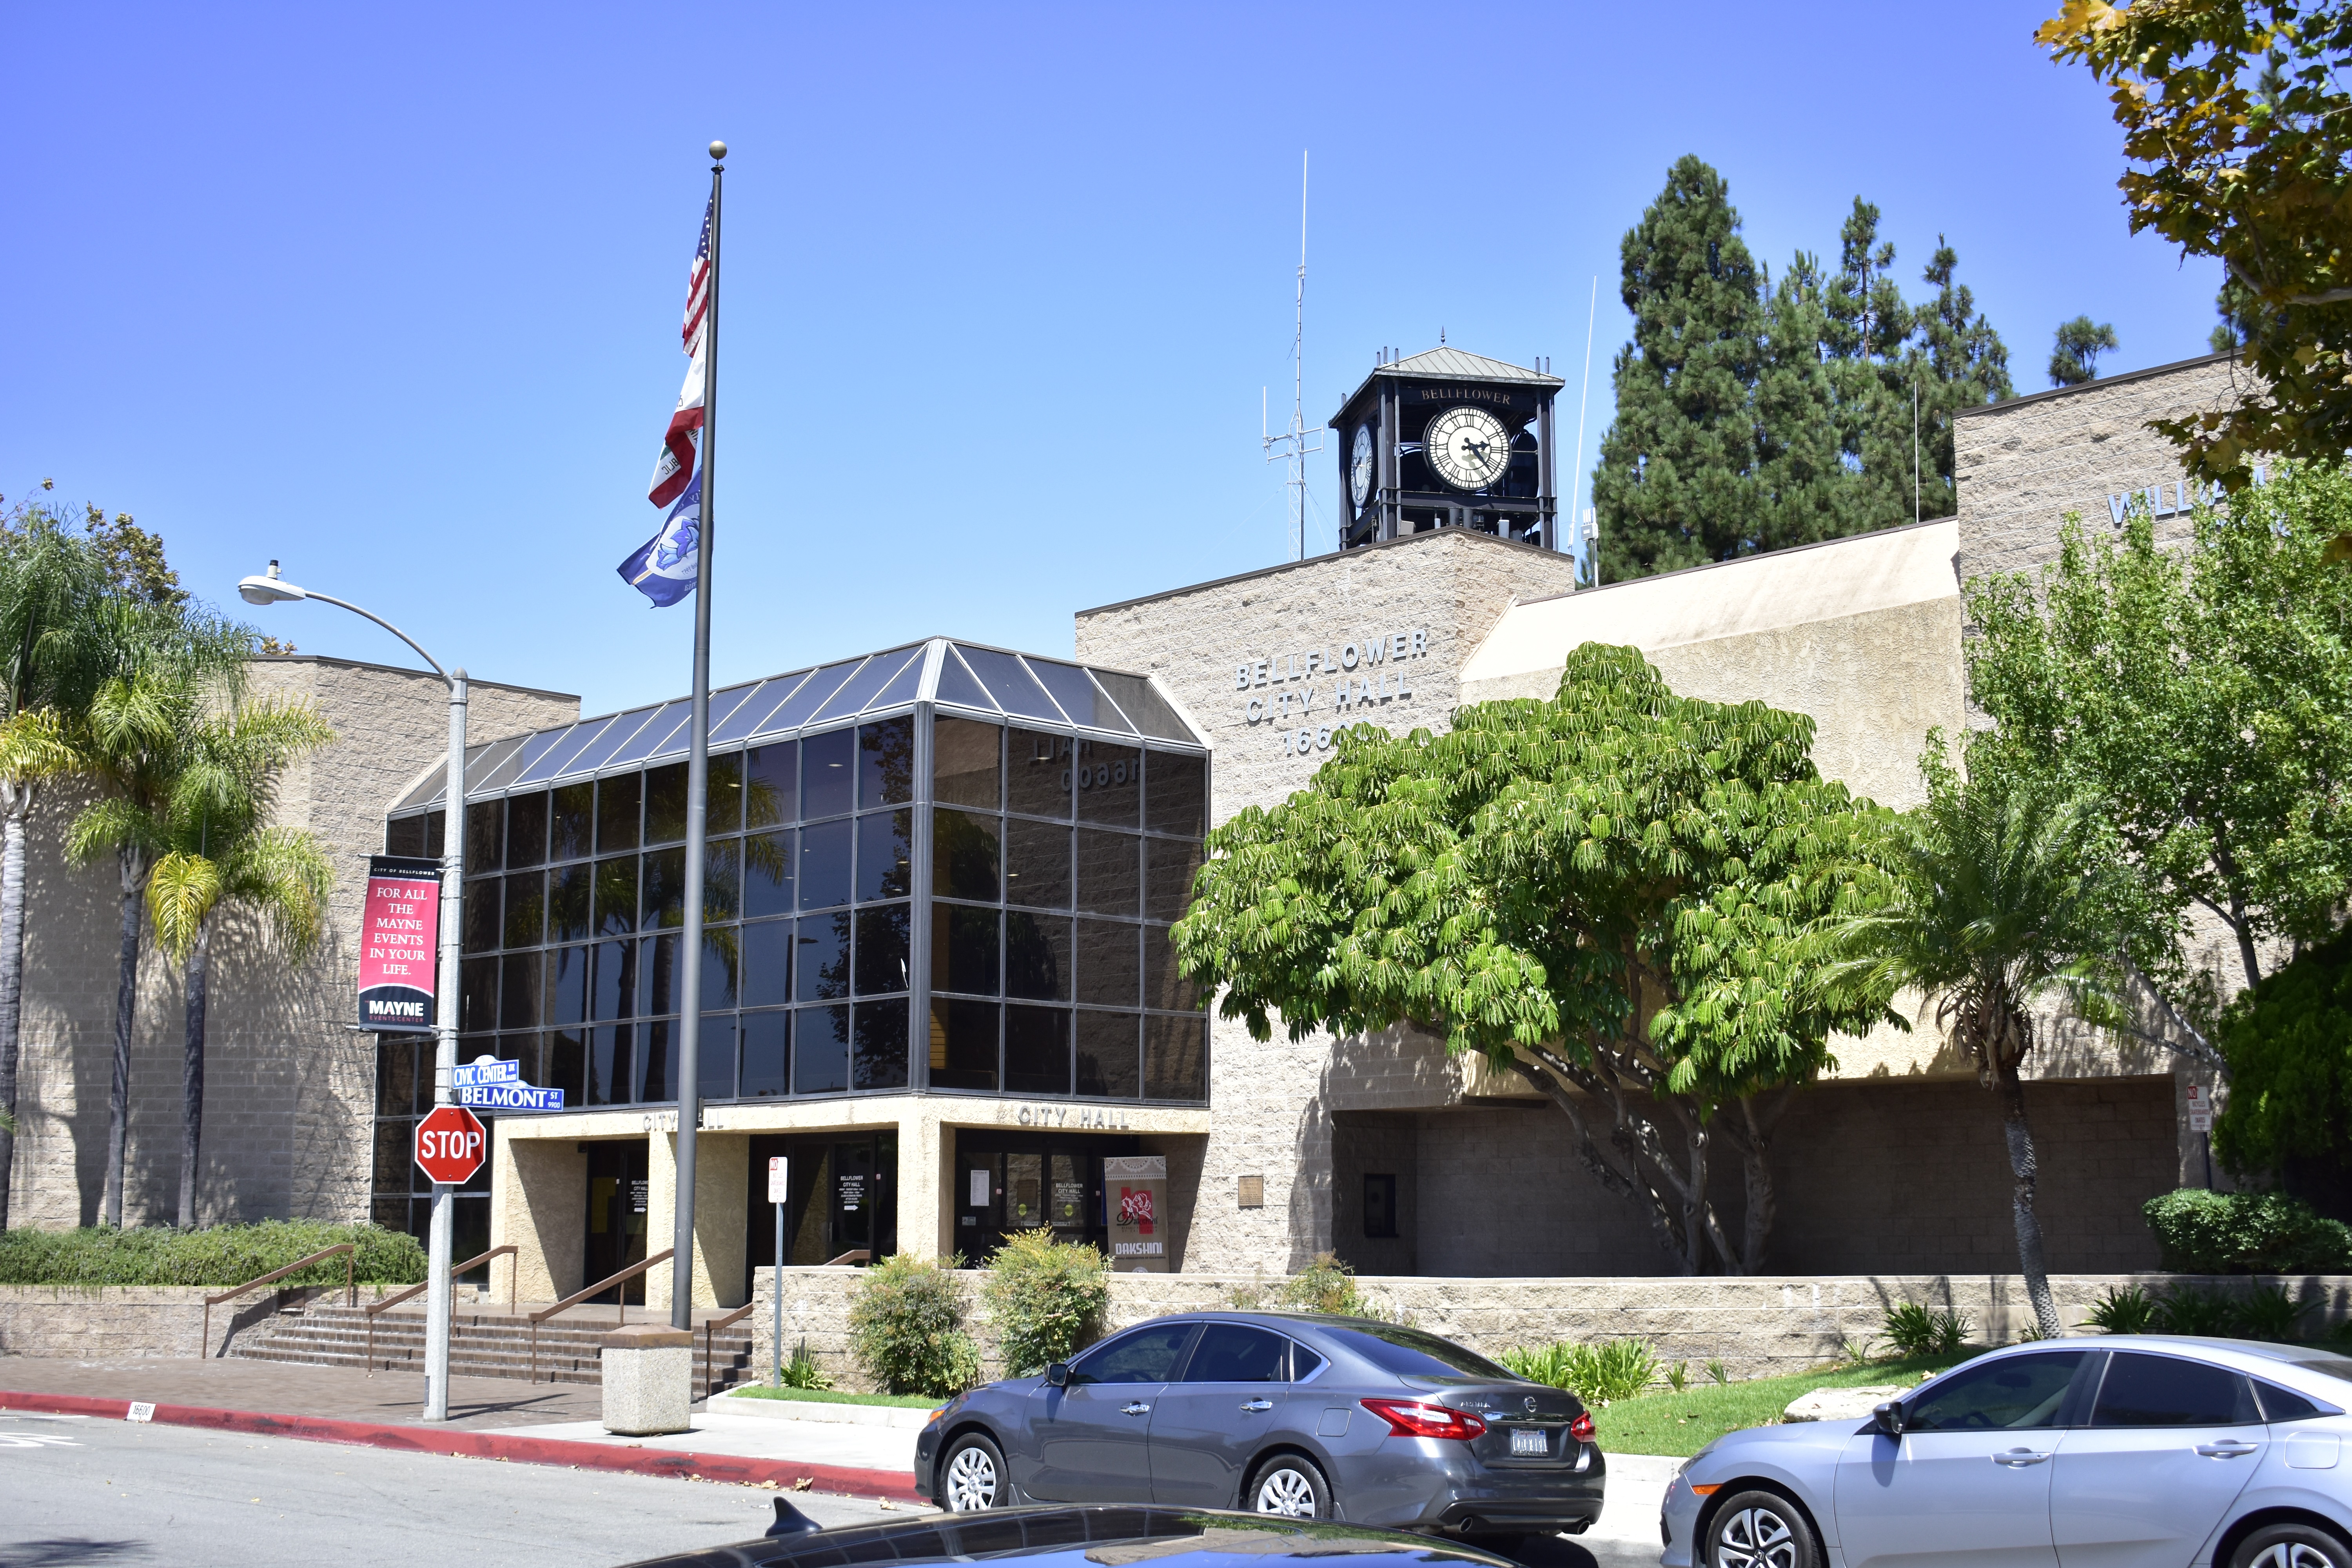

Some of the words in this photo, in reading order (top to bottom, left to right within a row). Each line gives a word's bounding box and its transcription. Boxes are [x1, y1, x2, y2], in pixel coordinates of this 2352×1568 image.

[1422, 389, 1510, 405] BELLFLOWER
[1236, 629, 1427, 689] BELLFLOWER
[1246, 687, 1313, 722] CITY
[1336, 670, 1412, 706] HALL
[376, 887, 401, 898] FOR
[403, 889, 428, 900] ALL
[388, 903, 414, 915] THE
[376, 918, 423, 930] MAYNE
[374, 933, 423, 946] EVENTS
[370, 948, 386, 958] IN
[388, 949, 426, 961] YOUR
[383, 964, 412, 975] LIFE.
[369, 1000, 424, 1016] MAYNE
[454, 1067, 476, 1086] CIVIC
[477, 1064, 507, 1084] CENTER
[508, 1063, 515, 1072] DR
[461, 1087, 548, 1108] BELMONT
[550, 1091, 558, 1100] ST
[2188, 1088, 2197, 1098] NO
[643, 1112, 677, 1130] CITY
[1019, 1105, 1066, 1124] CITY
[1080, 1108, 1129, 1126] HALL
[421, 1130, 481, 1159] STOP
[770, 1159, 778, 1170] NO
[1115, 1242, 1163, 1255] DAKSHINI
[133, 1405, 151, 1416] 16600
